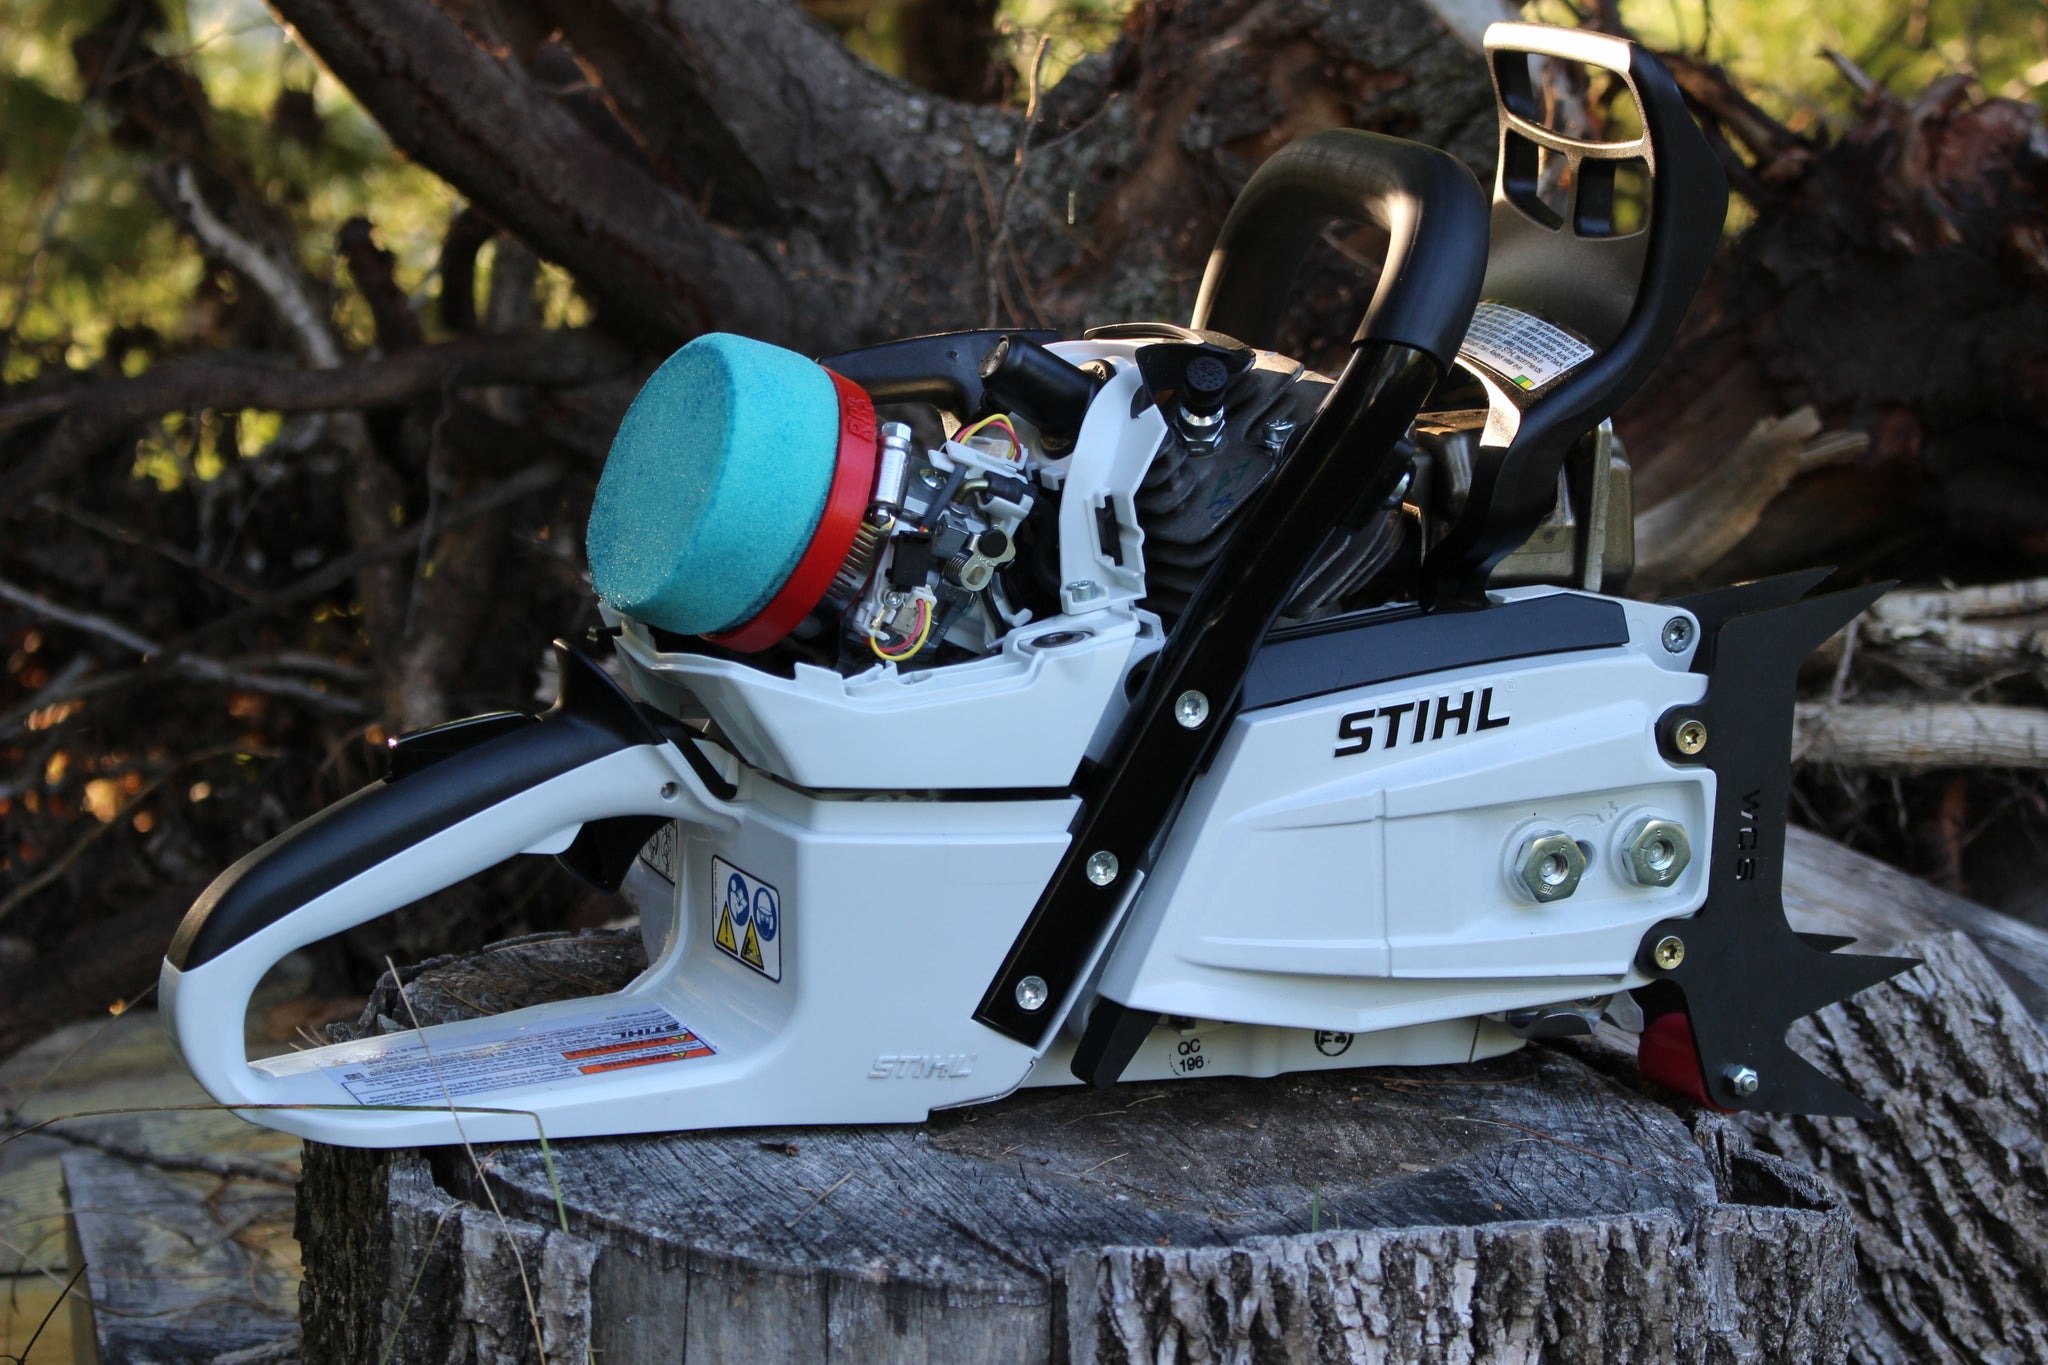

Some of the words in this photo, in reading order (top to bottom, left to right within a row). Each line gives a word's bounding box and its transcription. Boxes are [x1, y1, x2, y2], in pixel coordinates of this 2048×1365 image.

[1334, 686, 1511, 758] STIHL
[1735, 788, 1761, 881] WCS
[612, 1023, 679, 1038] STIHL
[1178, 1038, 1201, 1056] QC
[867, 1055, 972, 1079] STIHL
[1179, 1055, 1204, 1073] 196
